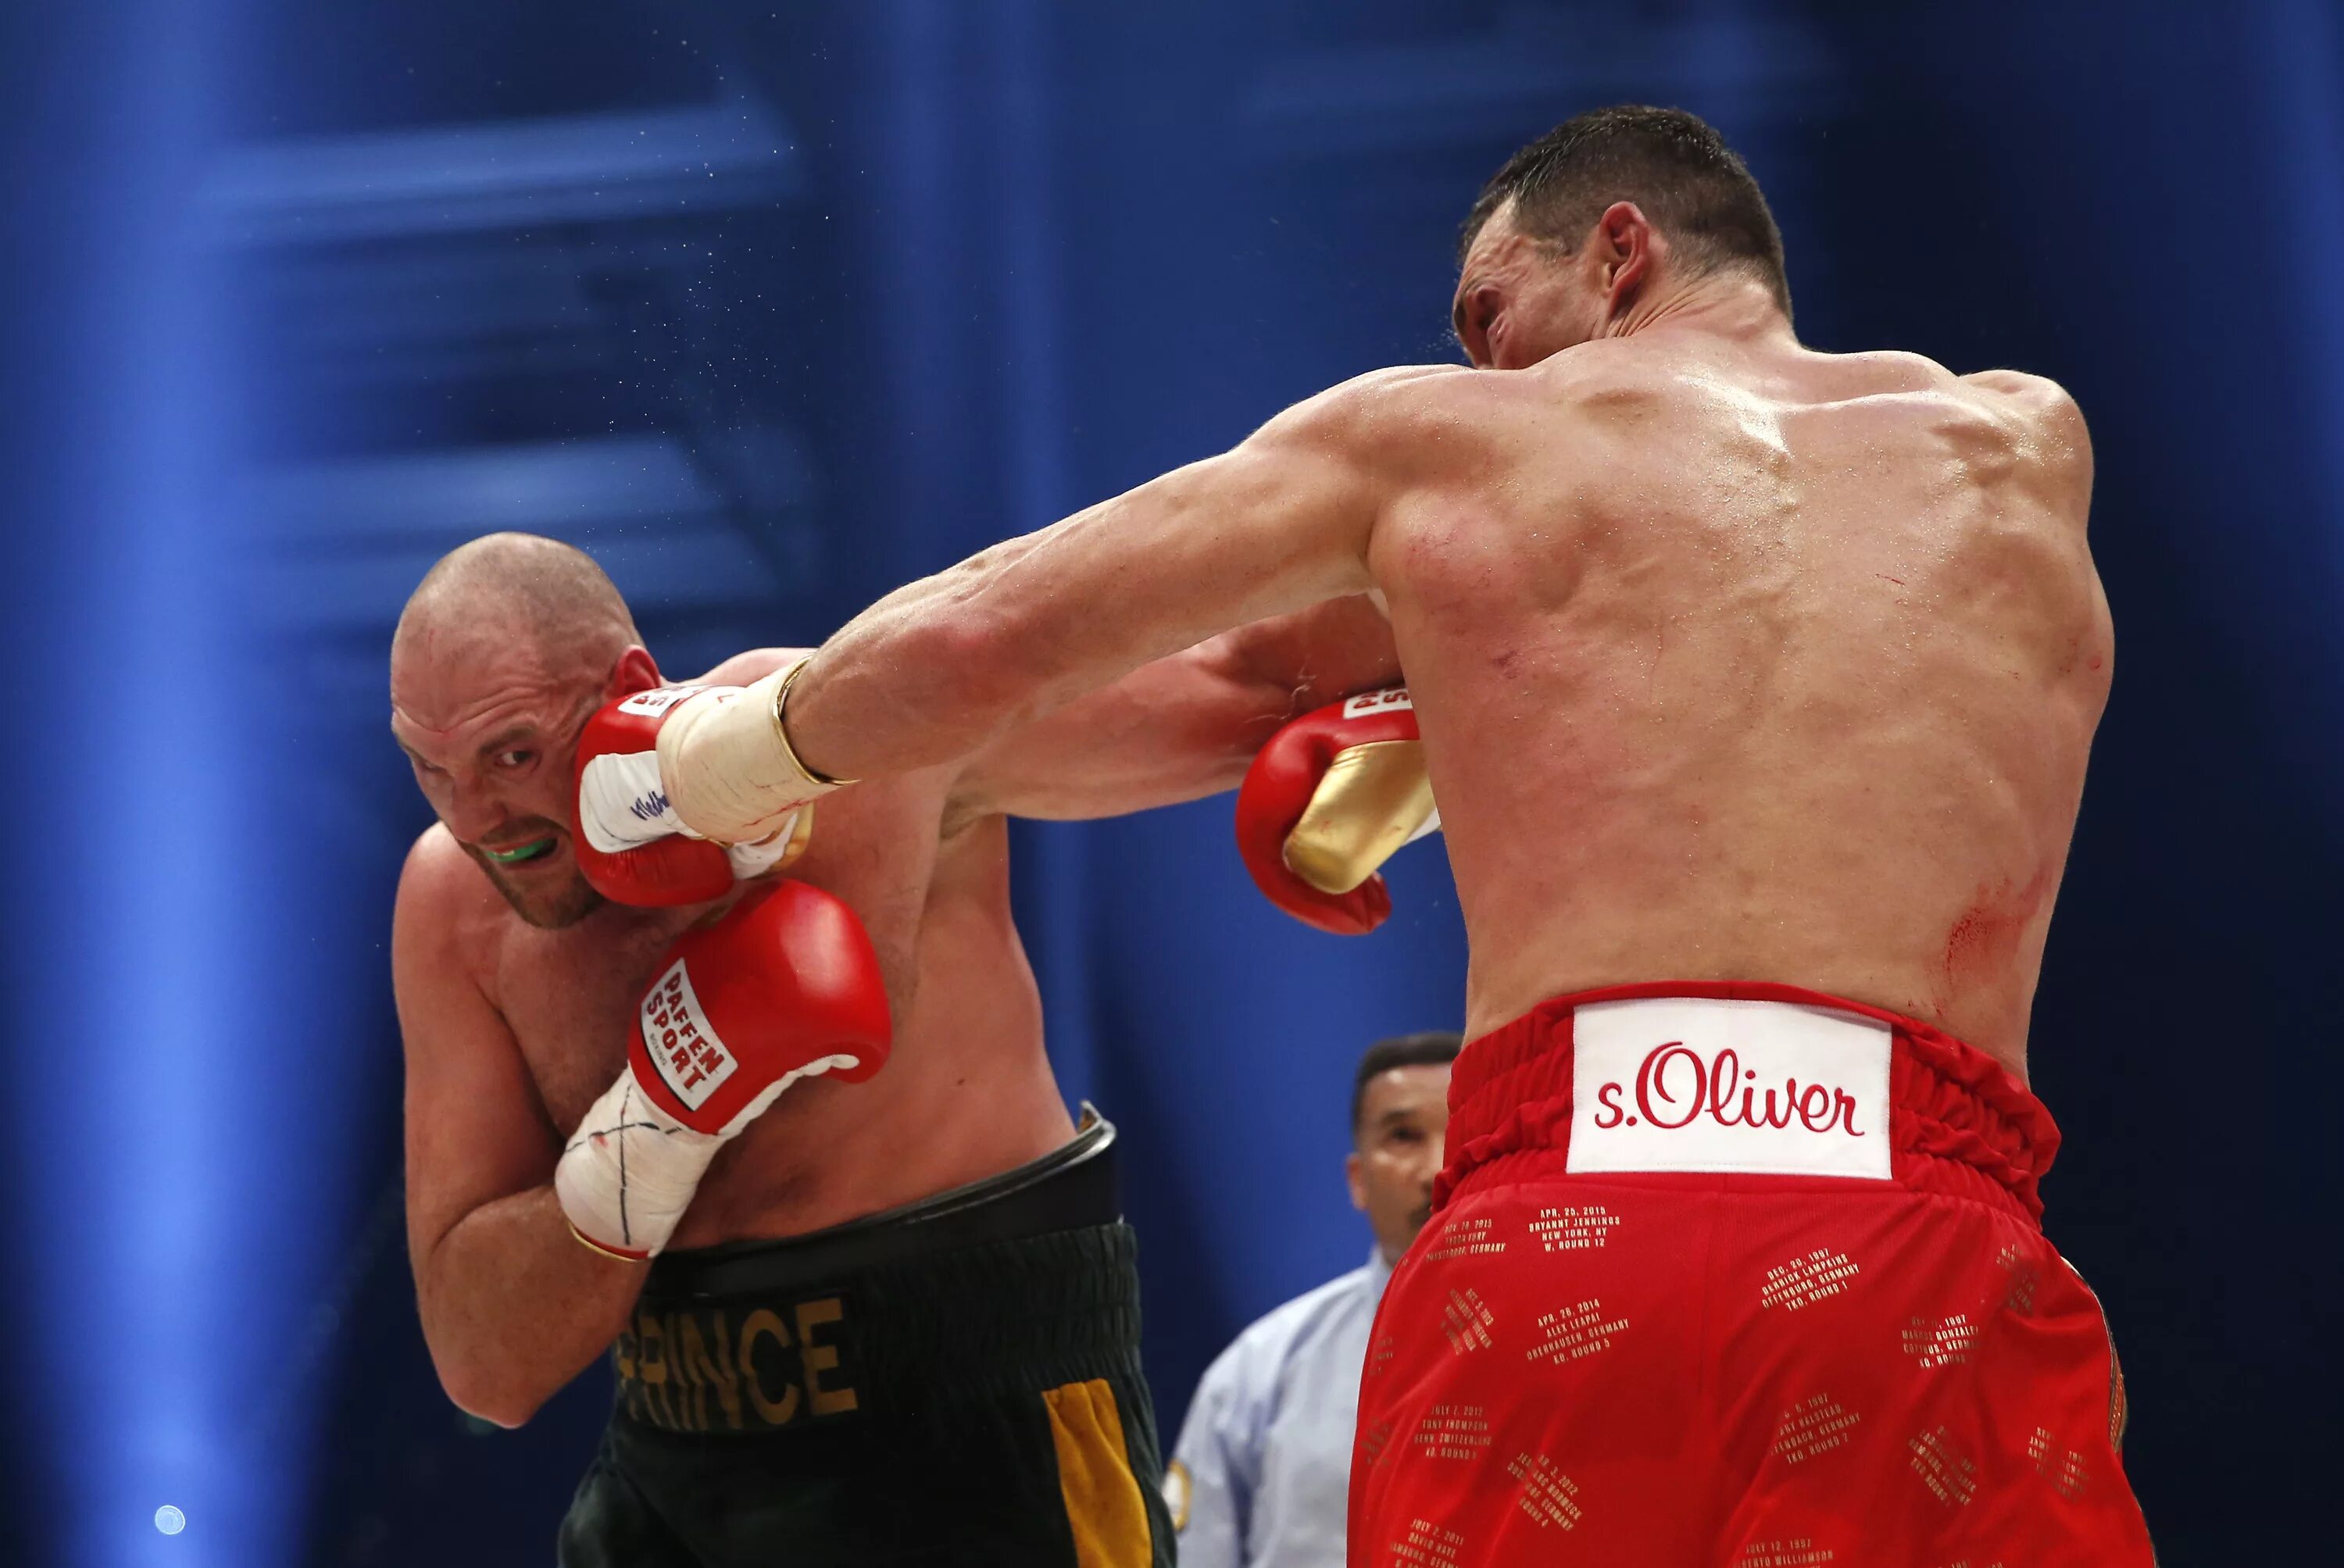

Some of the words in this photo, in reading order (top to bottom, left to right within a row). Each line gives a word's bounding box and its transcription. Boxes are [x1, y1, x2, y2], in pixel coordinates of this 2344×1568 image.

[665, 971, 725, 1075] PAFFEN
[647, 991, 706, 1089] SPORT
[1595, 1041, 1865, 1136] s.Oliver
[1583, 1206, 1606, 1216] 2015
[1573, 1216, 1620, 1227] JENNINGS
[1542, 1230, 1561, 1241] NEW
[1595, 1227, 1607, 1236] NY
[1470, 1242, 1506, 1254] GERMANY
[1558, 1238, 1590, 1250] ROUND
[1594, 1238, 1605, 1247] 12
[1808, 1248, 1830, 1263] 1997
[1762, 1270, 1801, 1296] DERRICK
[1802, 1253, 1849, 1277] LAMPKINS
[1762, 1279, 1817, 1309] OFFENBURG,
[1818, 1263, 1860, 1284] GERMANY
[1808, 1283, 1840, 1302] ROUND
[1842, 1280, 1848, 1290] 1
[1578, 1298, 1600, 1313] 2014
[1547, 1323, 1567, 1338] ALEX
[1570, 1312, 1600, 1330] LEAPAI
[1588, 1318, 1629, 1338] GERMANY
[1945, 1314, 1967, 1327] 1997
[1571, 1341, 1601, 1359] ROUND
[1603, 1338, 1610, 1348] 5
[1431, 1405, 1449, 1416] JULY
[1423, 1419, 1442, 1429] TONY
[1819, 1412, 1860, 1435] GERMANY
[1441, 1447, 1470, 1460] ROUND
[1809, 1436, 1840, 1455] ROUND
[1774, 1549, 1833, 1566] WILLIAMSON
